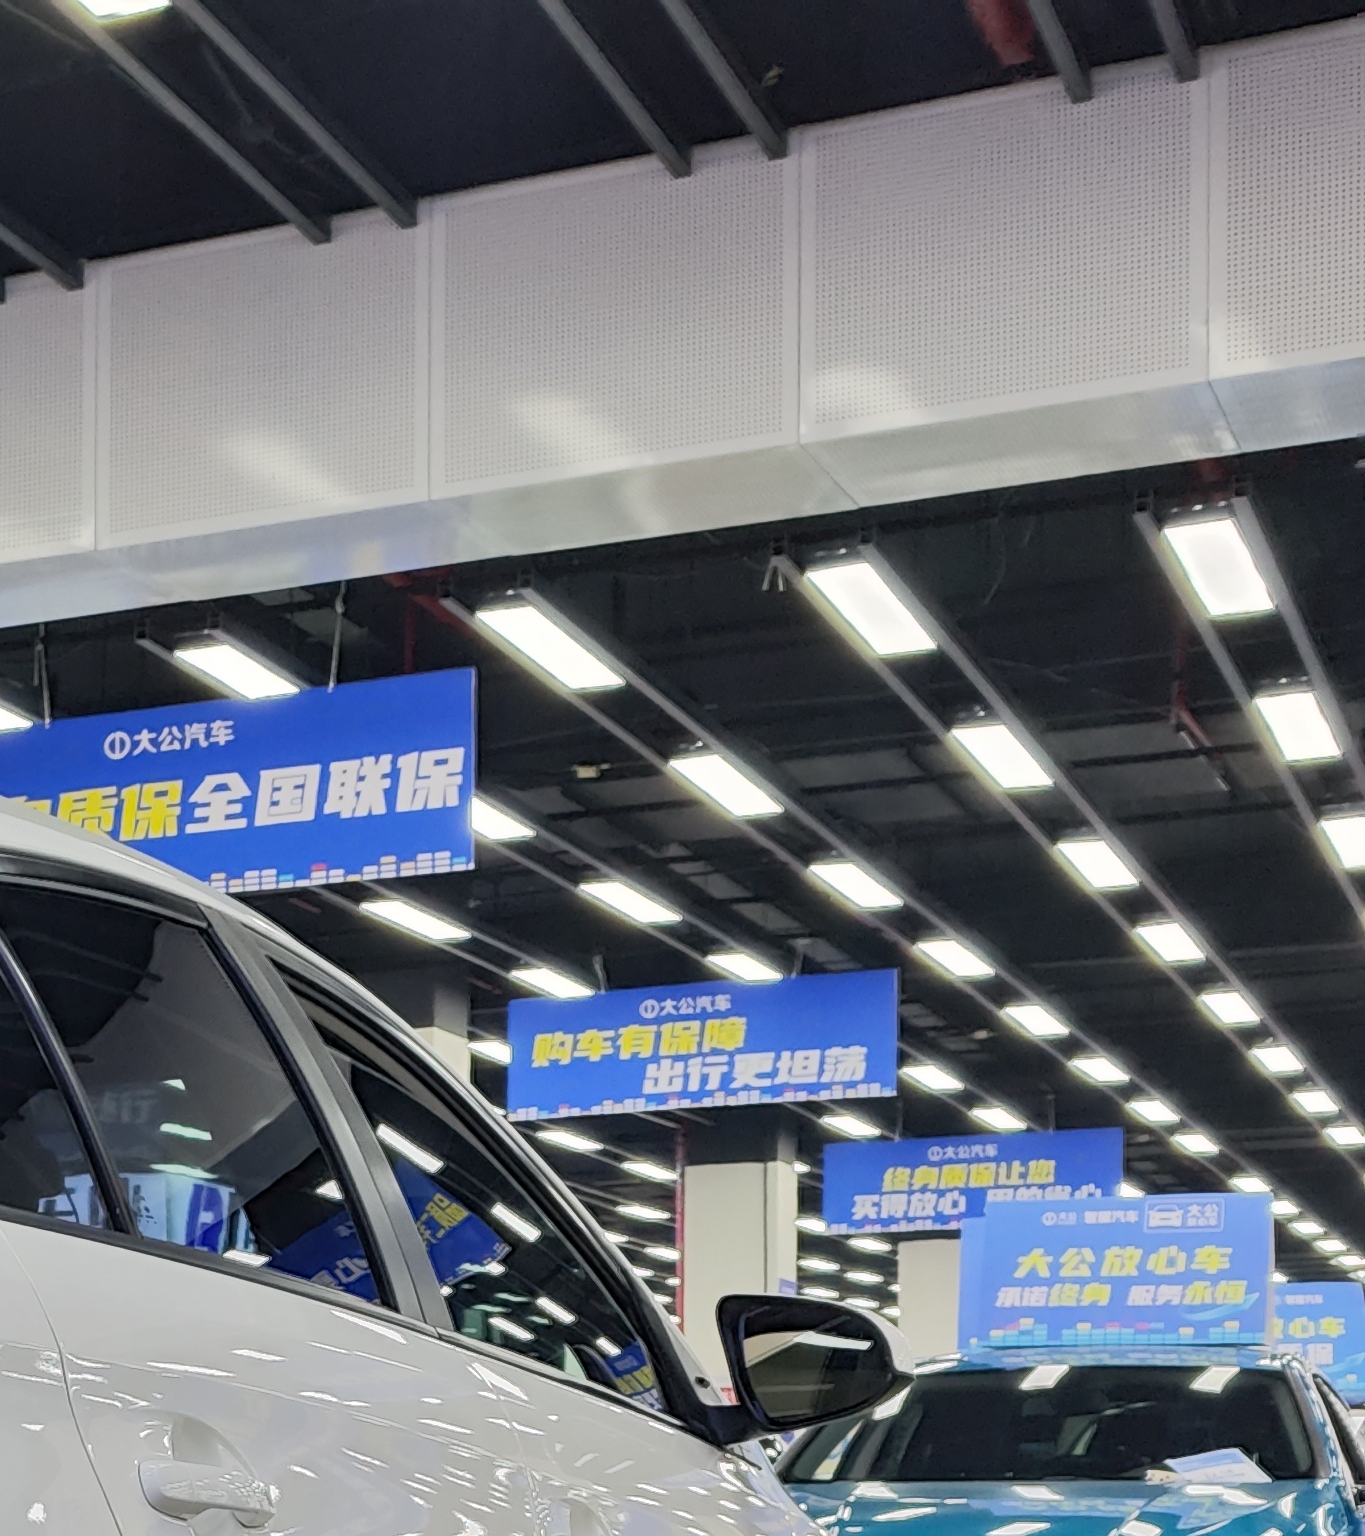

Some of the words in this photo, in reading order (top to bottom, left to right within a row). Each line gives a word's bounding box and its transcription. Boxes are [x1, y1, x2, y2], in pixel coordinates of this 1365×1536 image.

[132, 719, 234, 756] 大公汽车
[9, 746, 465, 842] 质保全国联保
[659, 995, 732, 1016] 大公汽车
[531, 1016, 748, 1068] 购车有保障
[642, 1046, 869, 1095] 出行更坦荡
[942, 1144, 999, 1160] 大公汽车
[851, 1190, 967, 1220] 买得放心
[1013, 1244, 1234, 1279] 大公放心车
[995, 1282, 1112, 1308] 承诺终身
[1127, 1280, 1248, 1306] 服务永恒
